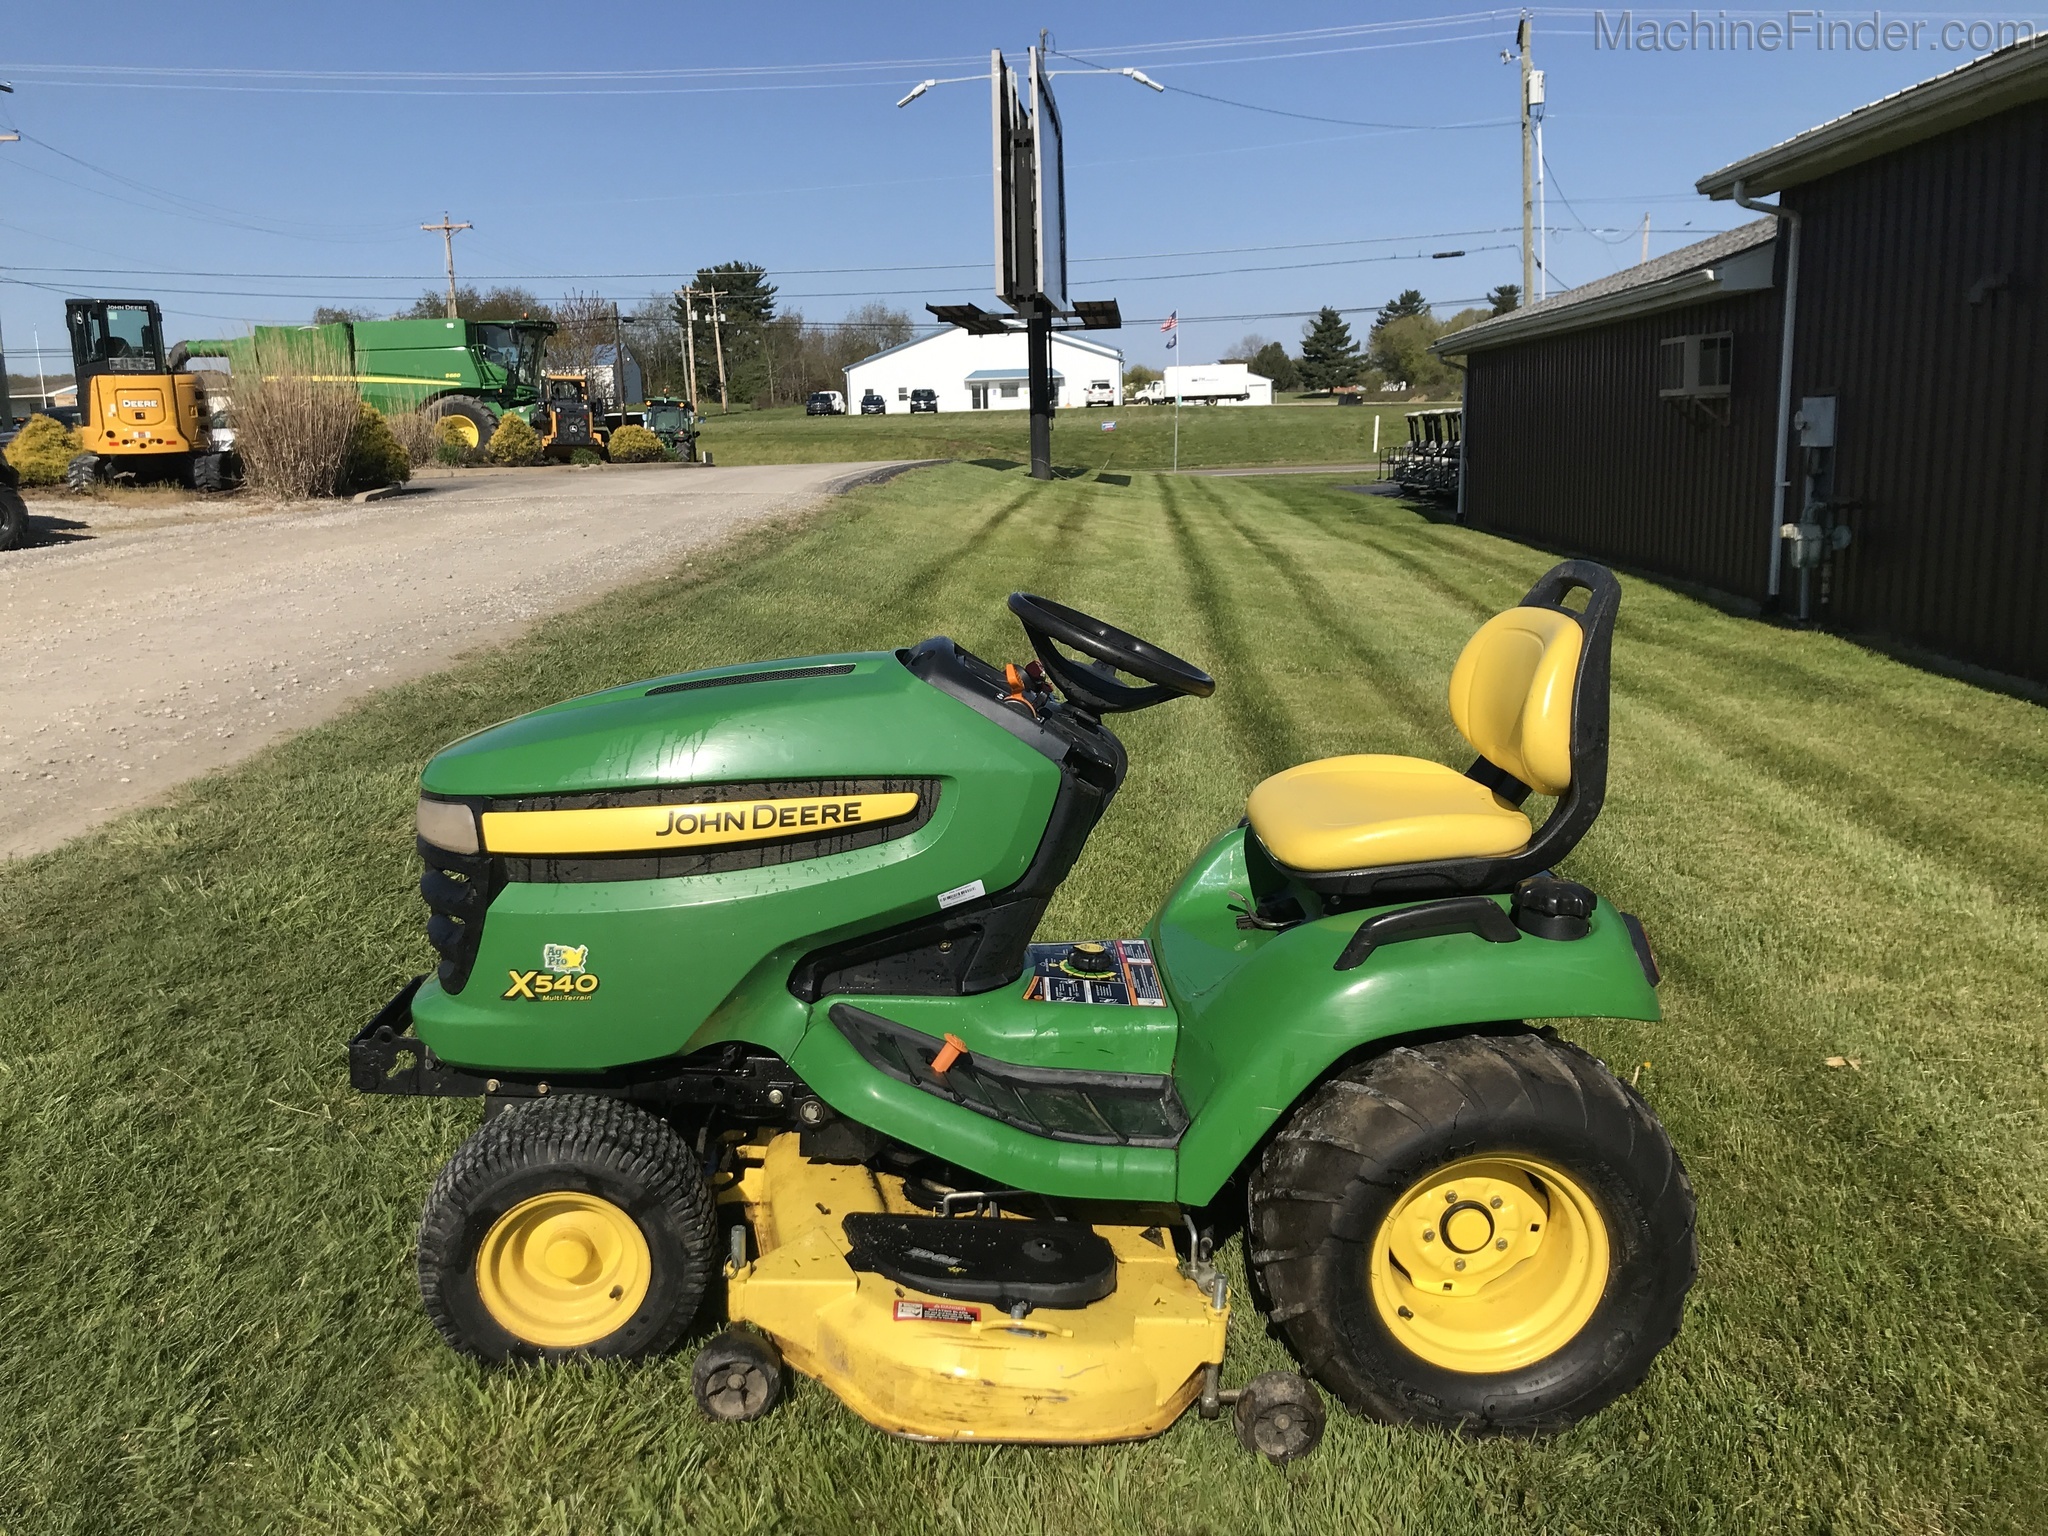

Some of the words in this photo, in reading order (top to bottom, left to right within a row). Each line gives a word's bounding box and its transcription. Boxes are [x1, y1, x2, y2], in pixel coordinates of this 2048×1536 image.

[123, 400, 158, 408] DEERE
[656, 810, 746, 836] JOHN
[752, 802, 862, 830] DEERE
[547, 957, 568, 966] Pro
[503, 970, 598, 998] X540
[542, 994, 592, 1002] Multi-Terrain
